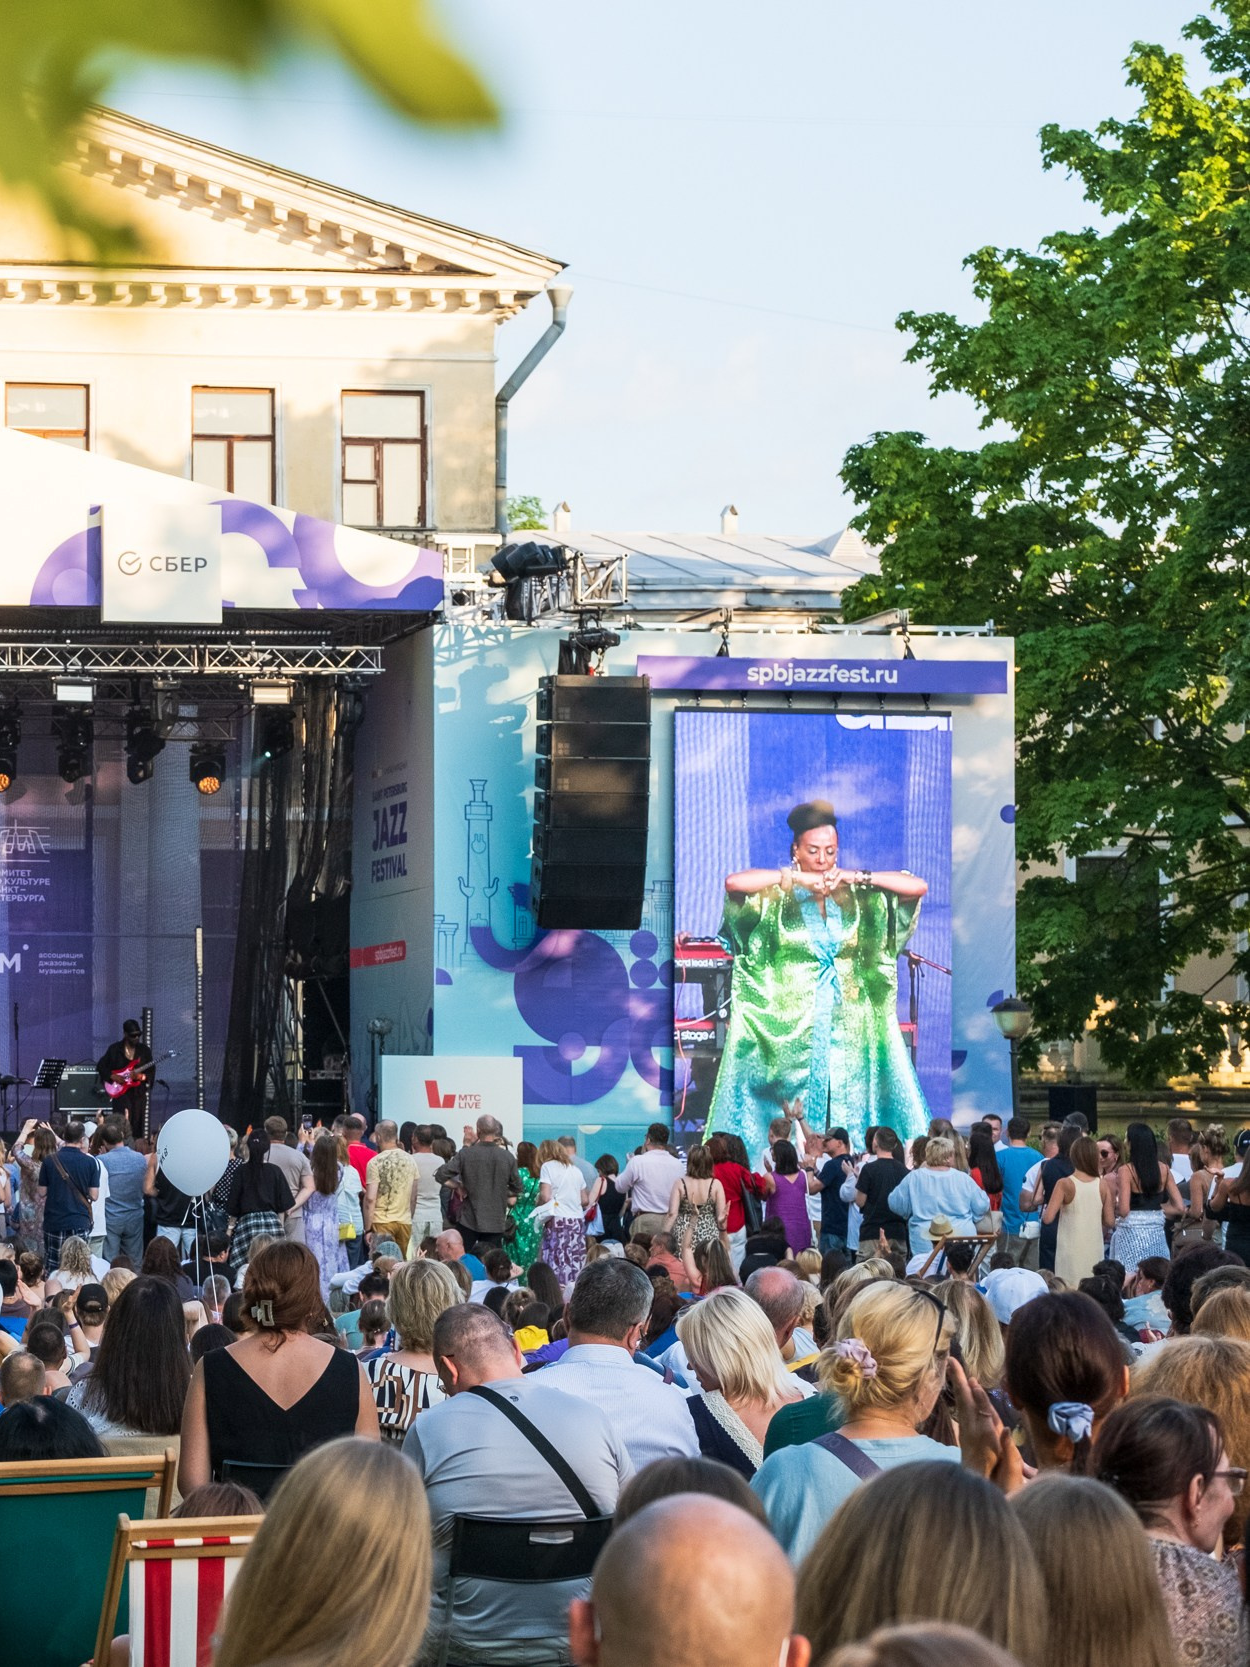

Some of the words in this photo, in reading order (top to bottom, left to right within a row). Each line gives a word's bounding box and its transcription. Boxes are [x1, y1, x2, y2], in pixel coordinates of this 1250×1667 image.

[149, 556, 208, 573] СБЕР
[747, 663, 898, 686] spbjazzfest.ru
[371, 800, 408, 852] JAZZ
[371, 853, 408, 884] FESTIVAL
[4, 878, 51, 886] КУЛЬТУРЕ
[681, 1030, 709, 1042] stage
